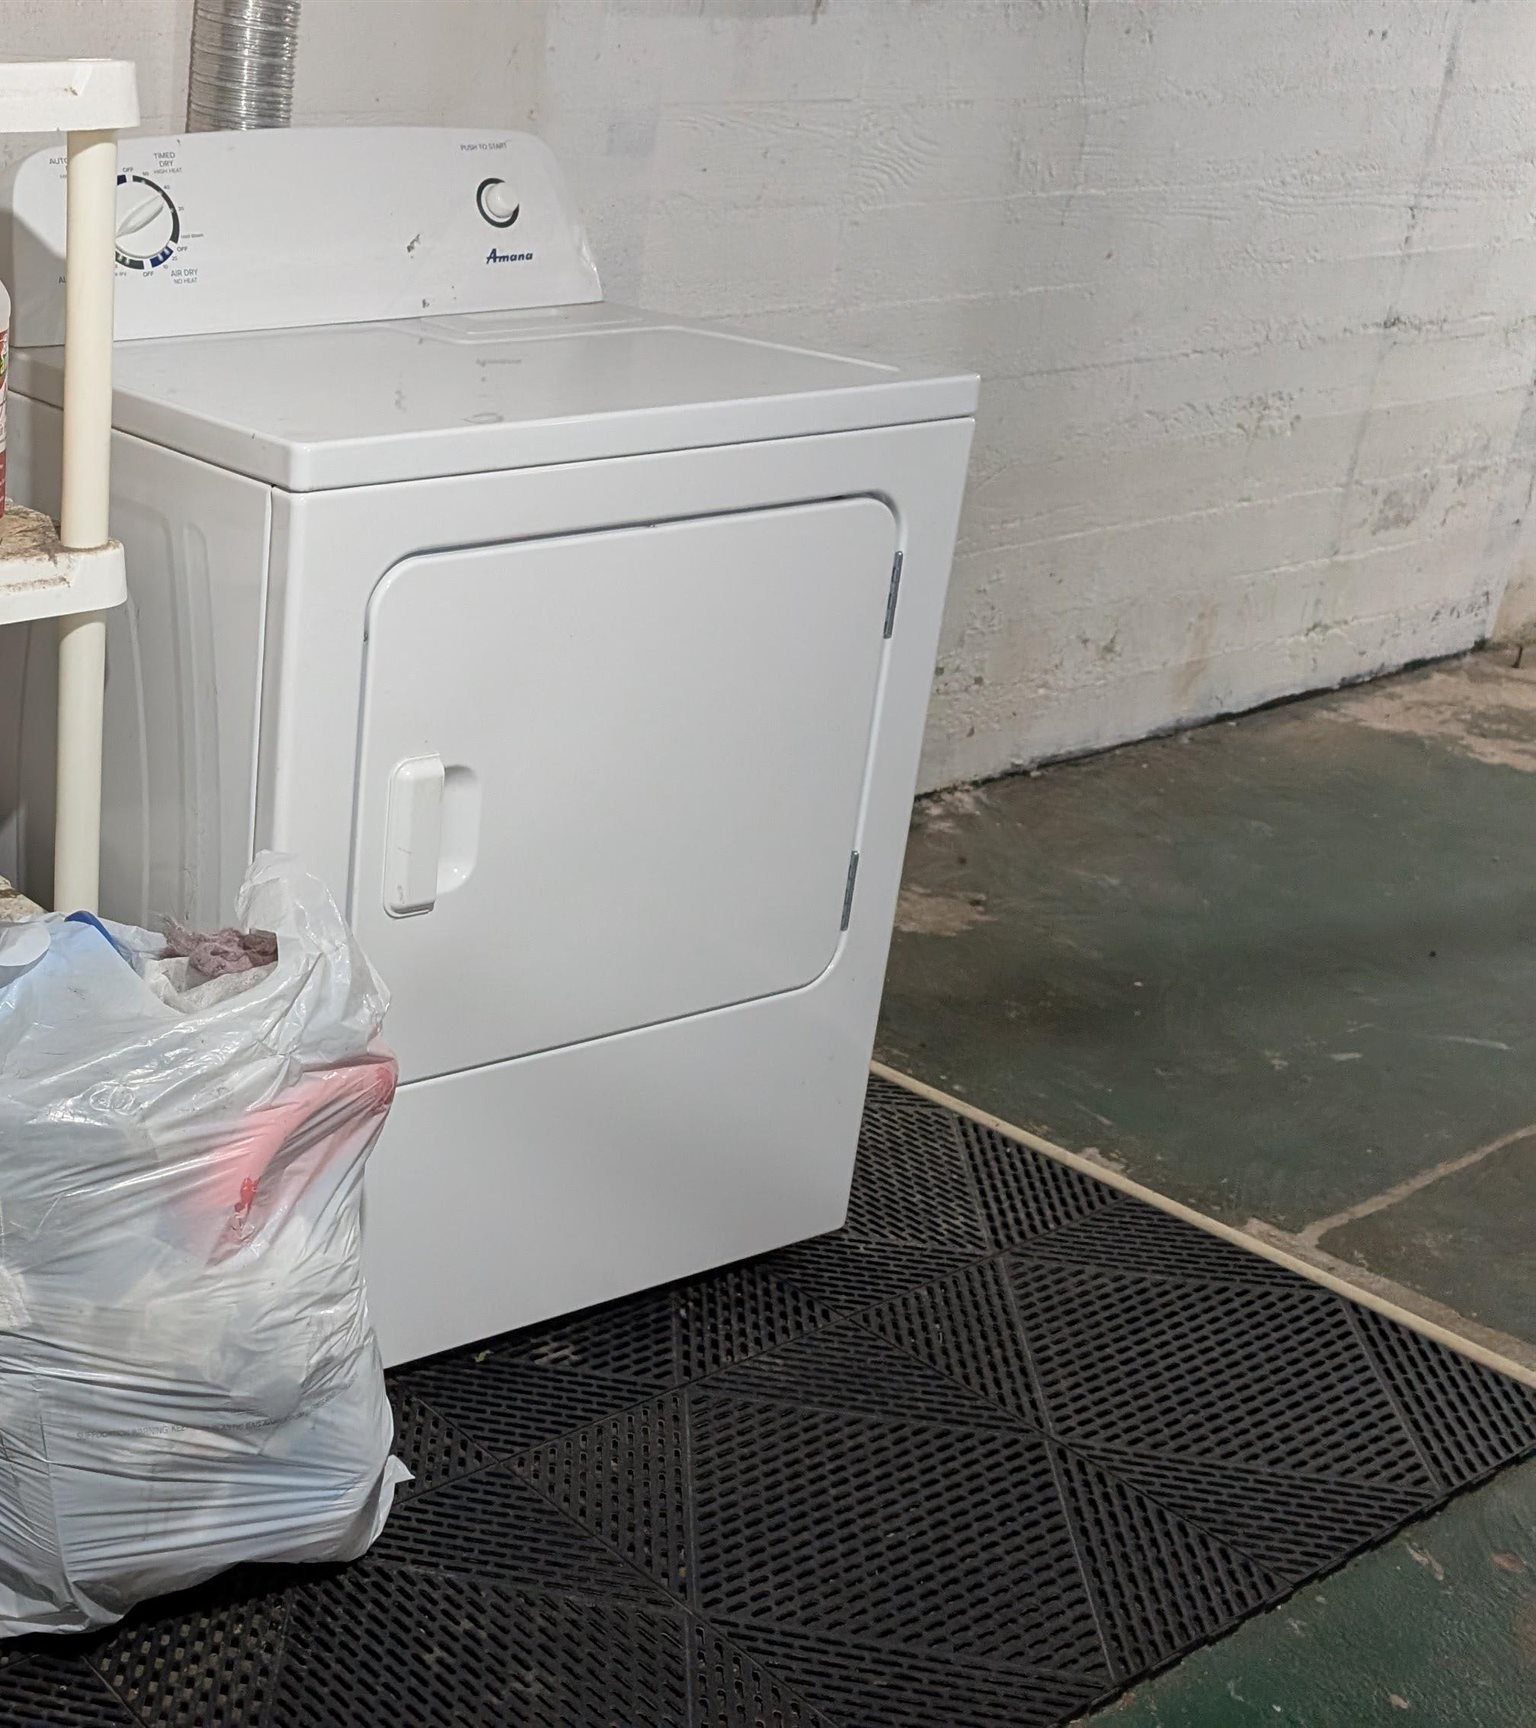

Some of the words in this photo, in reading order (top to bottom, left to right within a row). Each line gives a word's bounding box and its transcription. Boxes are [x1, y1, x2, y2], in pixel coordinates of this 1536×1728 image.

[488, 142, 507, 150] START
[154, 152, 175, 160] TIMED
[159, 160, 174, 168] DRY
[486, 248, 534, 265] Amana
[170, 269, 183, 277] AIR
[183, 268, 198, 276] DRY
